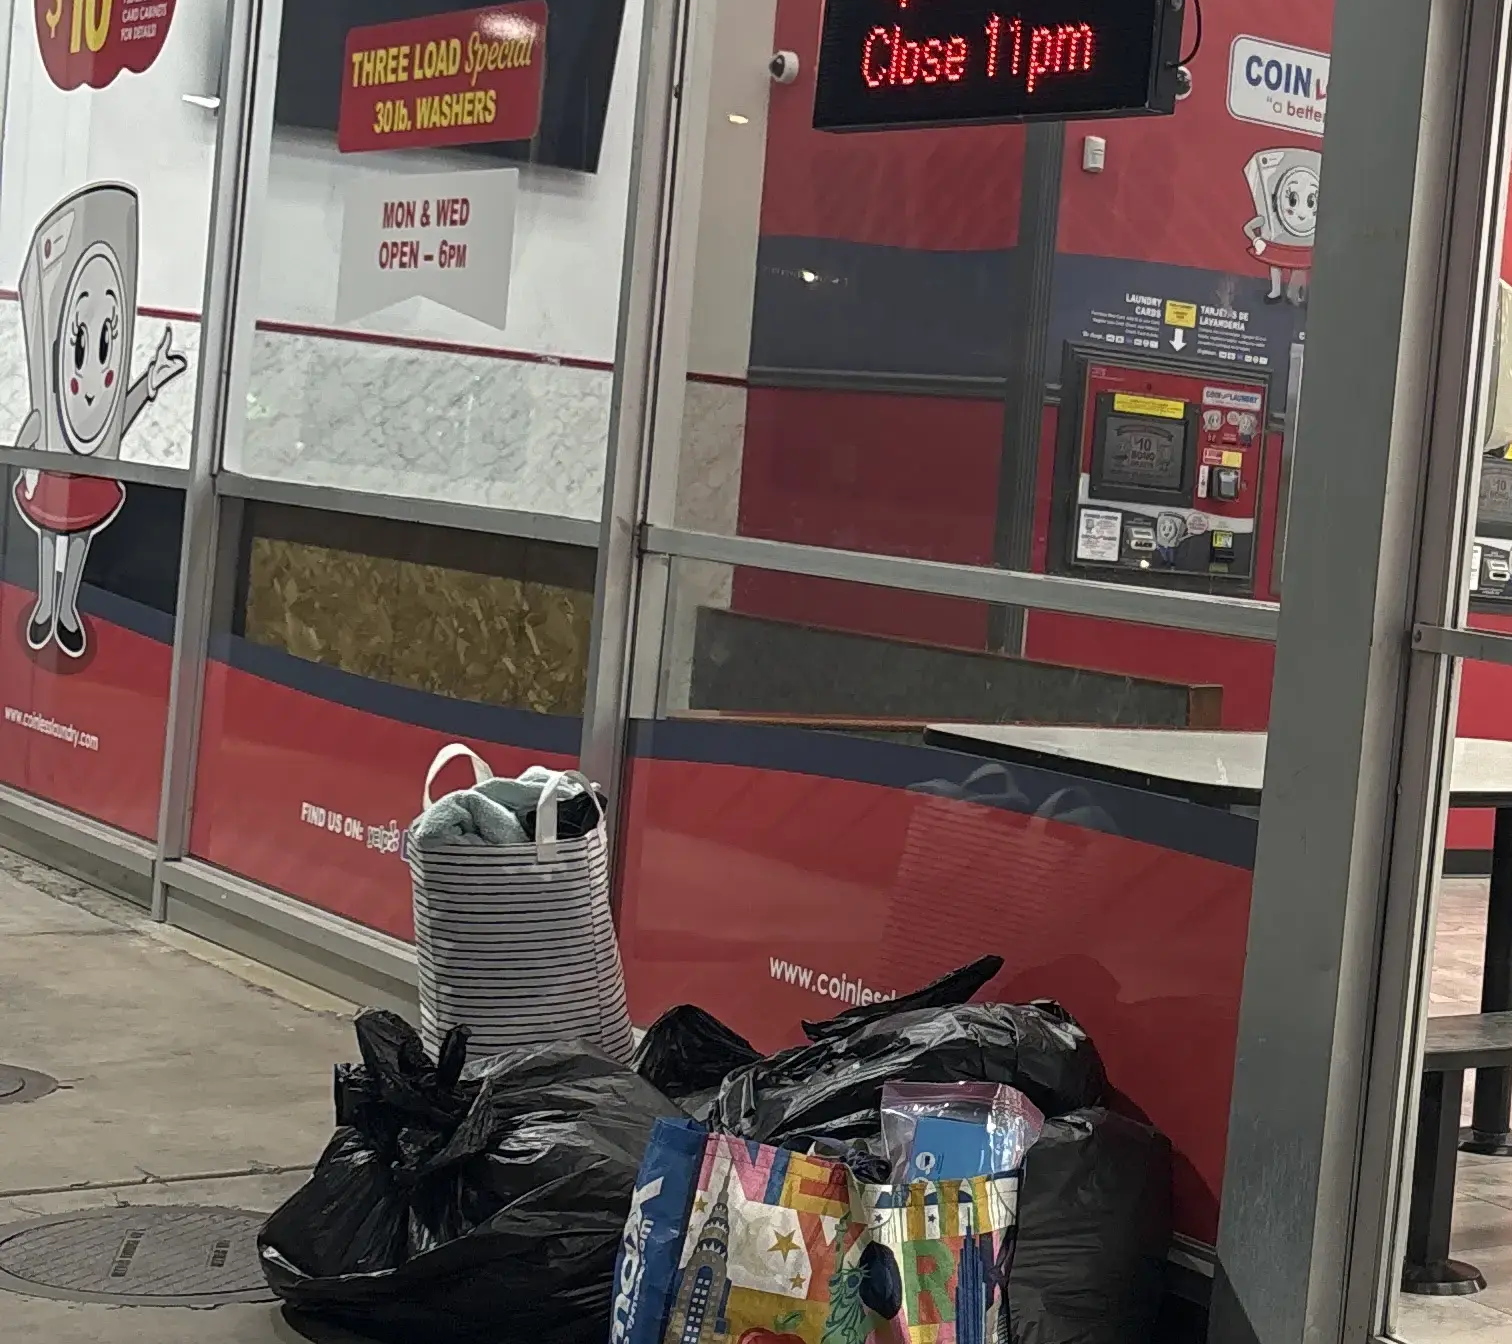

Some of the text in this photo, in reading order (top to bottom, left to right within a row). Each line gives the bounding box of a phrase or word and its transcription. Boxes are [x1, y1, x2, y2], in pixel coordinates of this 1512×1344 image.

[352, 31, 533, 88] THREE LOAD Special
[861, 12, 1095, 94] Close 11pm
[1245, 54, 1313, 99] COIN
[416, 89, 497, 131] WASHERS
[1286, 100, 1325, 123] bette
[382, 197, 470, 229] MON & WED
[378, 240, 420, 270] OPEN
[438, 239, 467, 269] 6PM
[1125, 292, 1163, 308] LAUNDRY
[1134, 306, 1162, 319] CARDS
[301, 801, 364, 842] FIND US ON:
